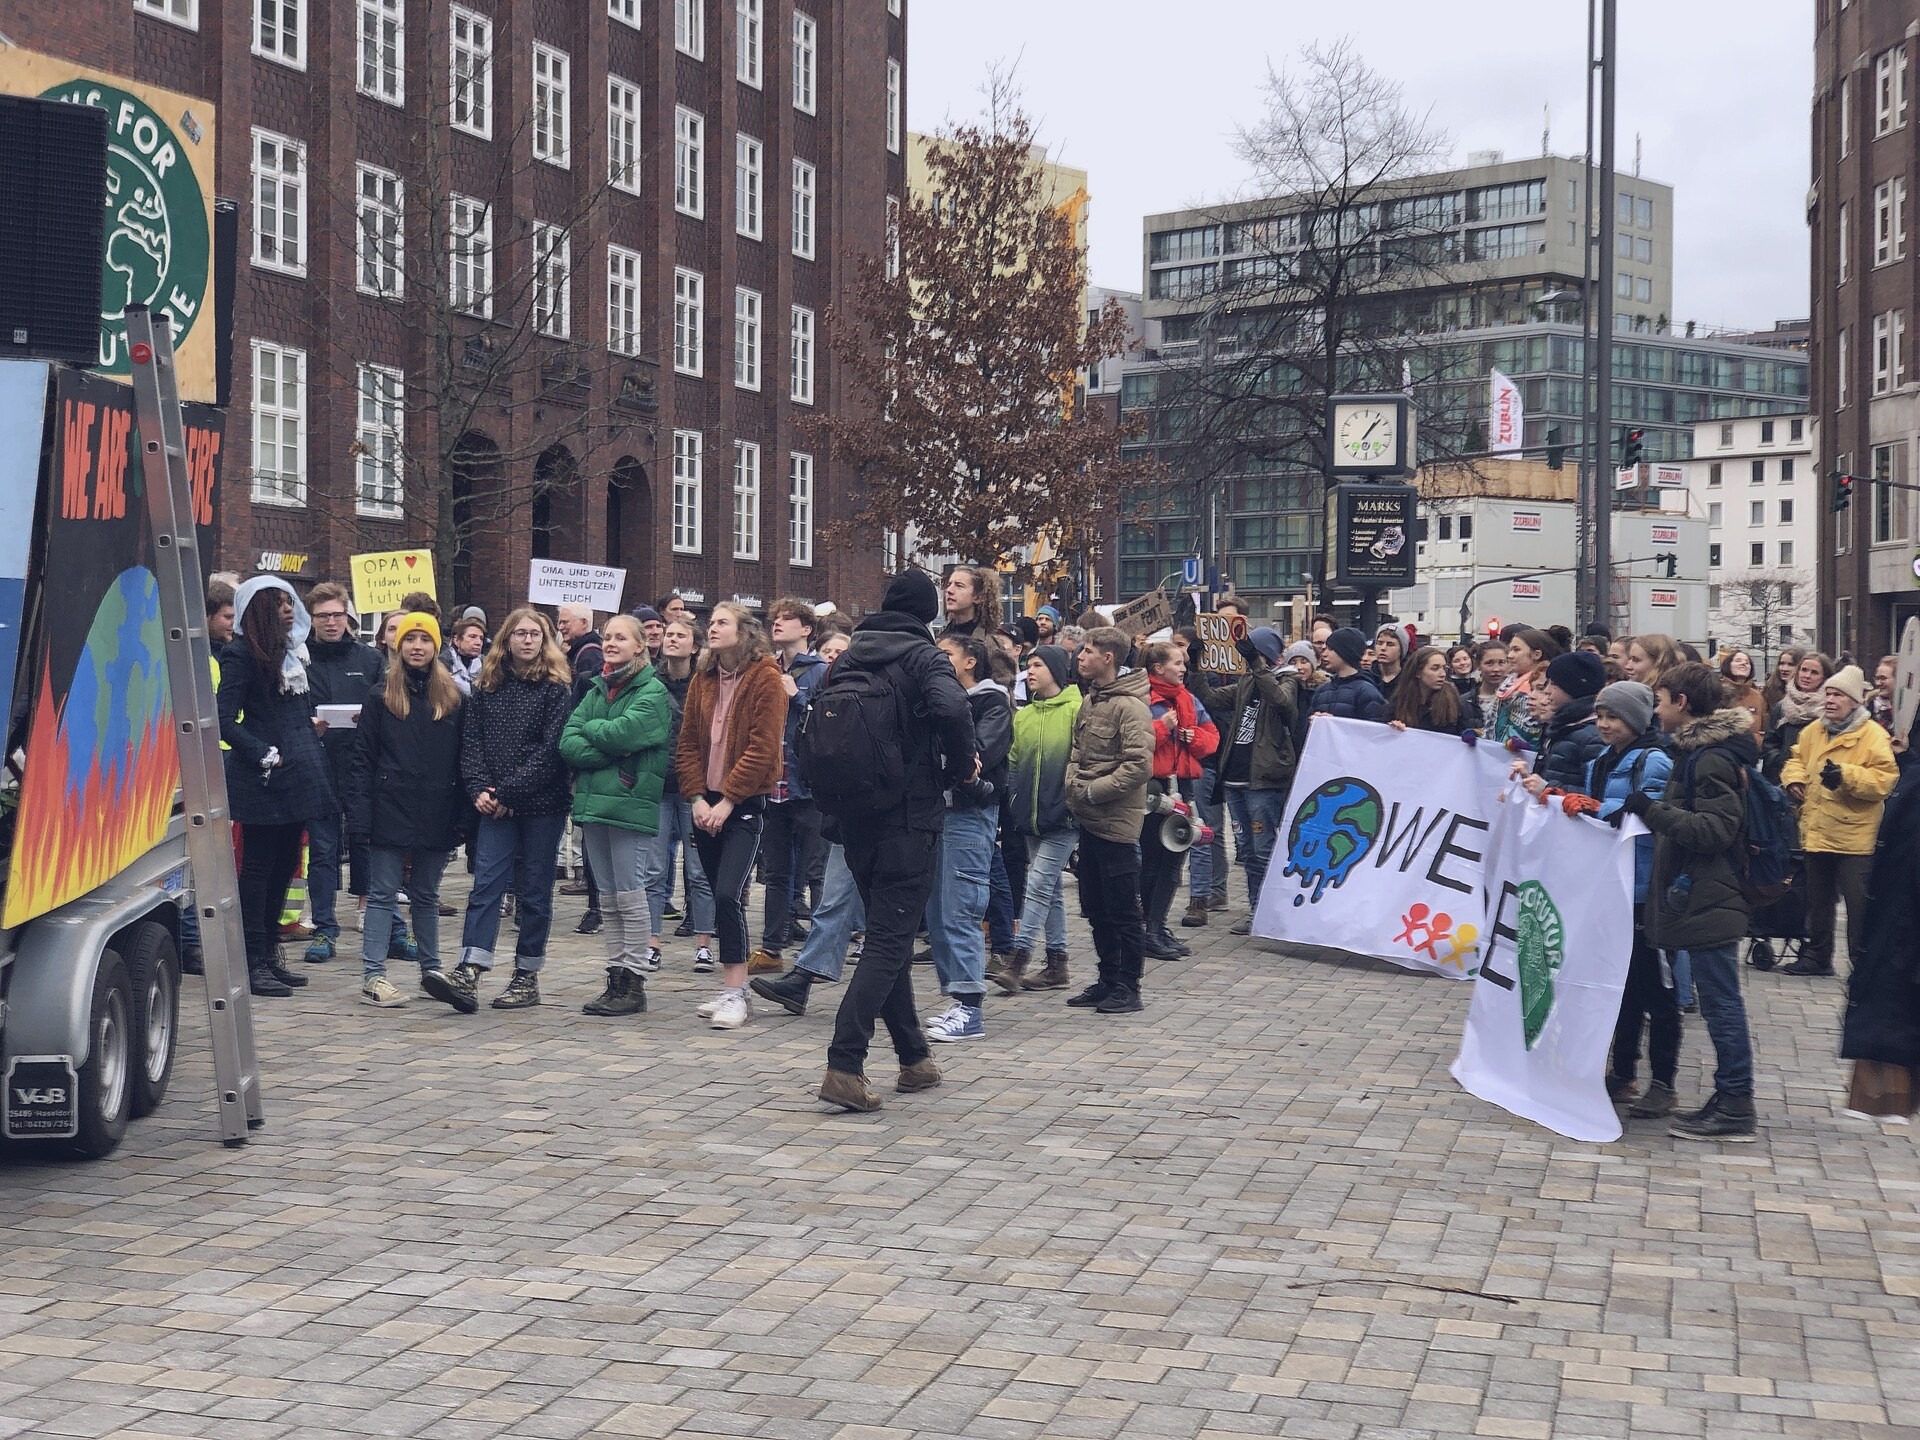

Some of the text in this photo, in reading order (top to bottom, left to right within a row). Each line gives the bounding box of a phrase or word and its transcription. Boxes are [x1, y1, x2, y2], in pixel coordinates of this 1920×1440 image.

[117, 100, 176, 180] FOR
[62, 399, 96, 519] WE
[93, 405, 131, 521] ARE
[1357, 500, 1401, 512] MARKS
[256, 551, 308, 573] SUBWAY
[364, 557, 400, 574] OPA
[367, 573, 421, 588] fridays for
[541, 565, 615, 579] OMA UND OPA
[1185, 561, 1197, 583] U
[538, 578, 617, 592] UNTERSTÜTZEN
[562, 593, 592, 603] EUCH
[1200, 617, 1230, 642] END
[1200, 644, 1243, 672] COAL!
